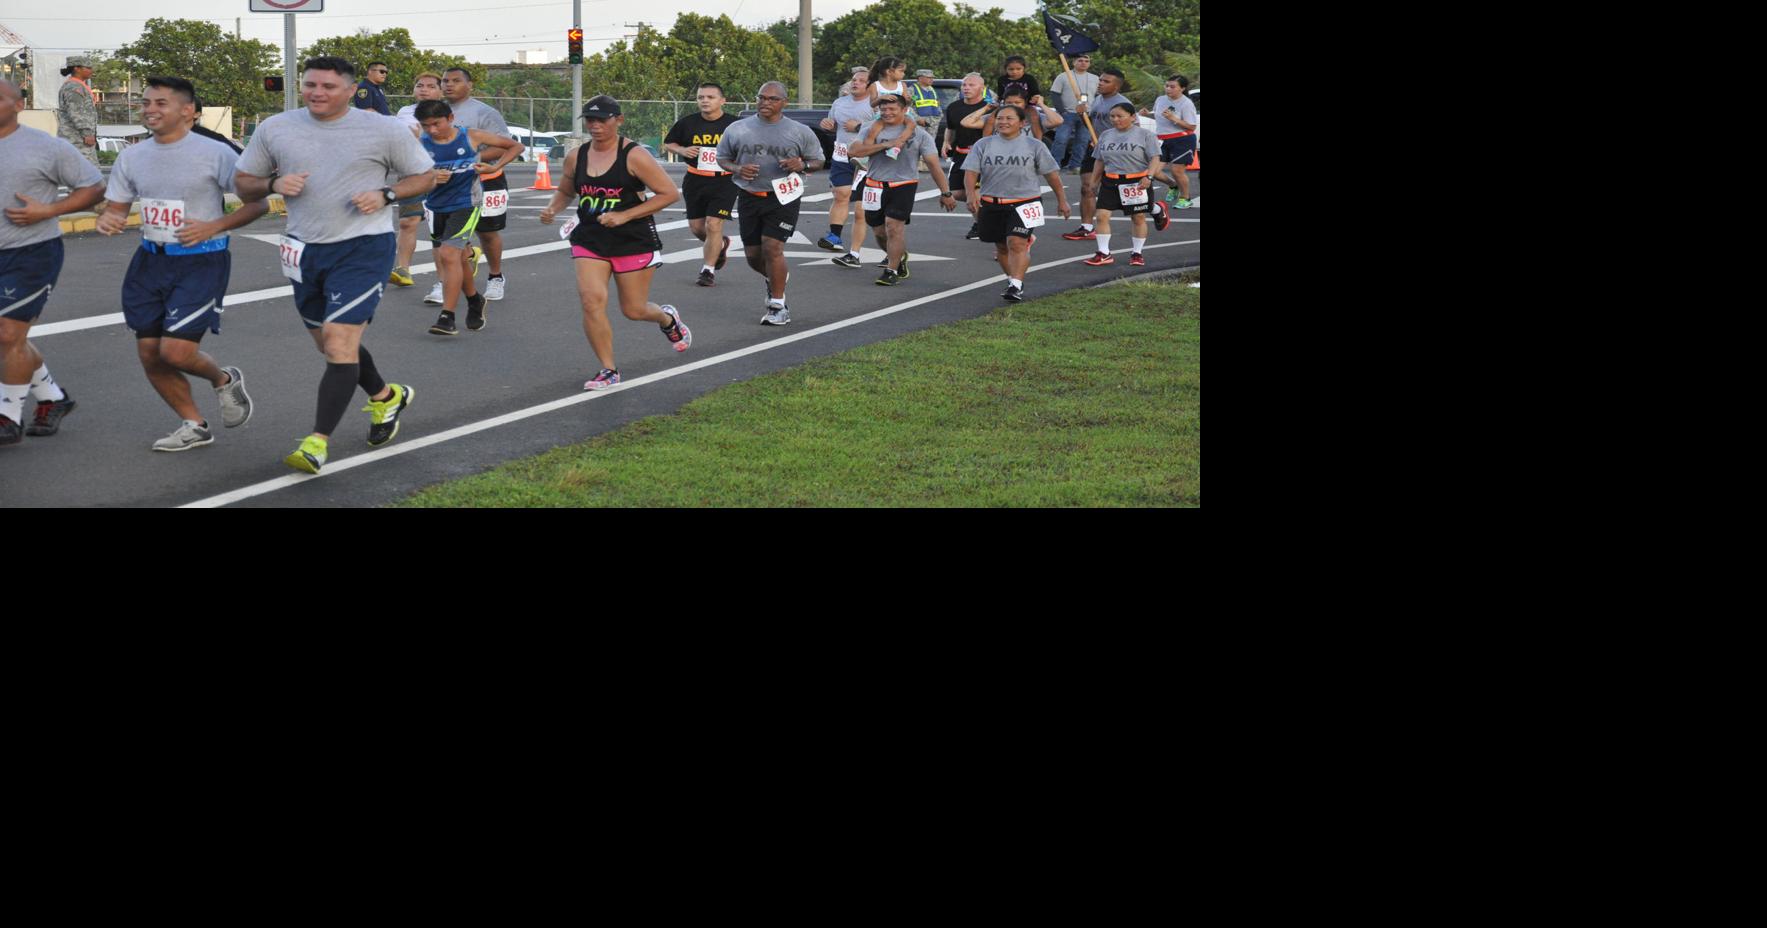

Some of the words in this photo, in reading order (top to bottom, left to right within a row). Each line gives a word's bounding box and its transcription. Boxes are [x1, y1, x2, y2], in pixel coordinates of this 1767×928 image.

[692, 134, 723, 145] ARM
[1099, 142, 1138, 152] ARMY
[702, 151, 716, 163] 86
[984, 155, 1029, 166] ARMY
[779, 177, 800, 194] 914
[486, 194, 506, 208] 864
[580, 195, 621, 214] OUT
[144, 206, 183, 228] 1246
